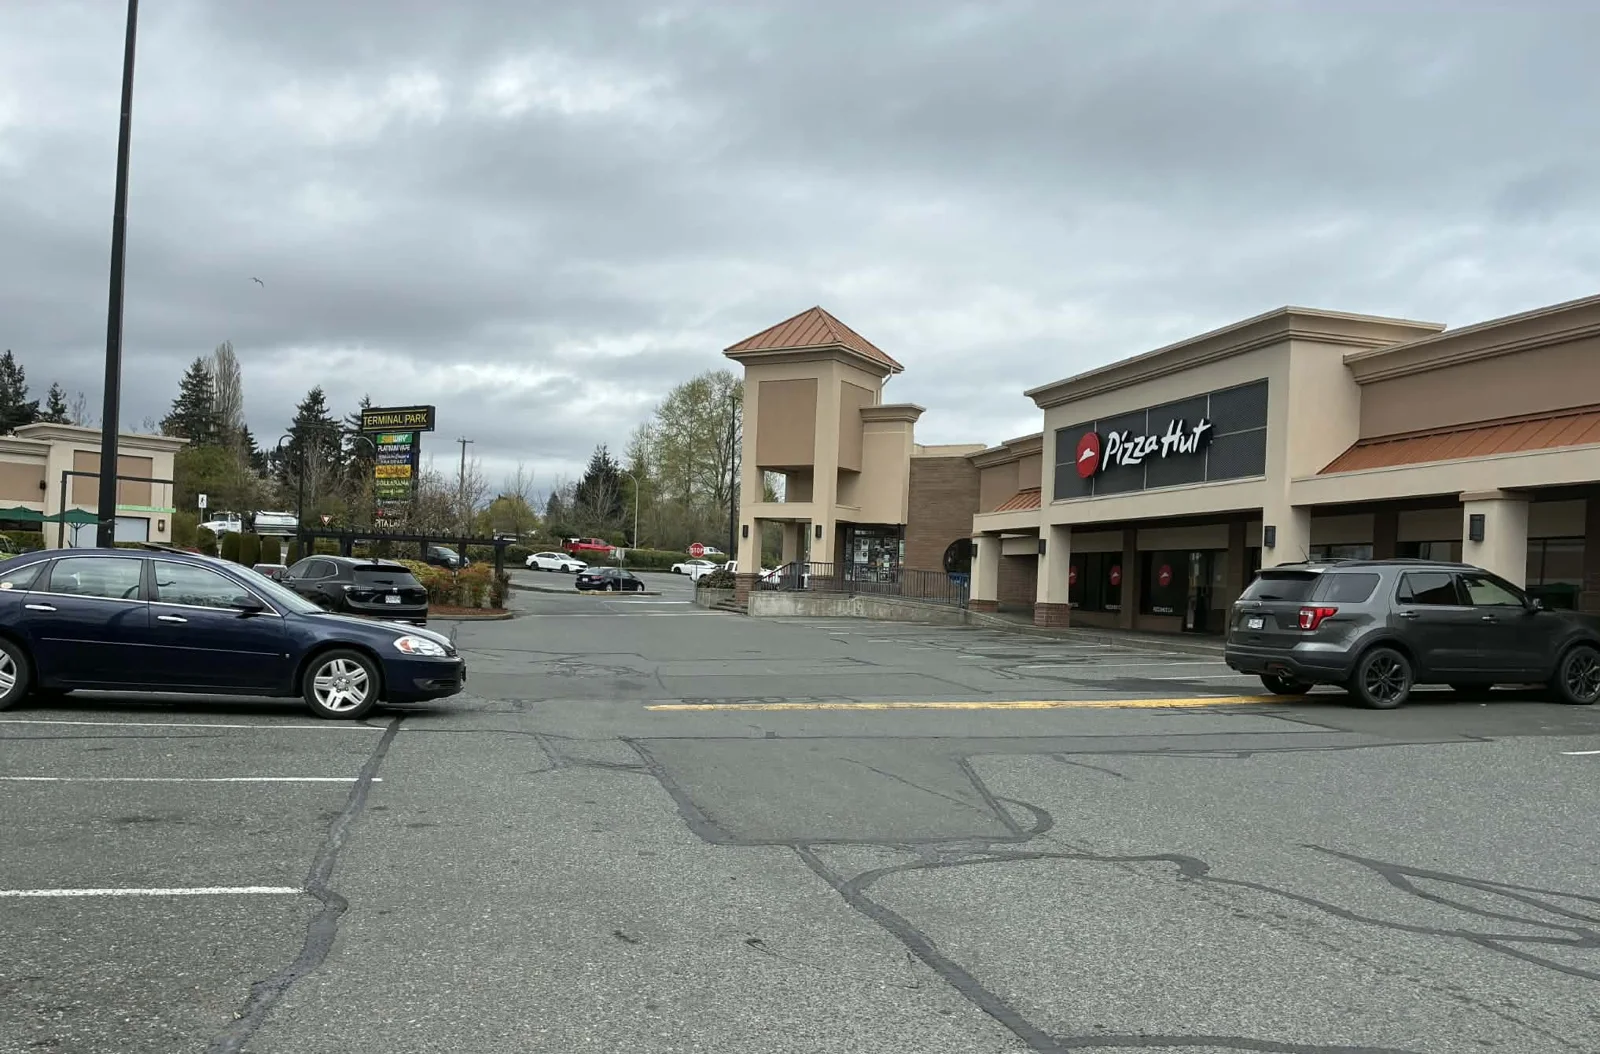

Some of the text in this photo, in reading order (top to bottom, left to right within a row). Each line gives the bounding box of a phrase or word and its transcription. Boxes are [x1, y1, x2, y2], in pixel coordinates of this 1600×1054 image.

[363, 413, 427, 426] TERMINAL PARK
[1102, 418, 1211, 471] Pizza Hut
